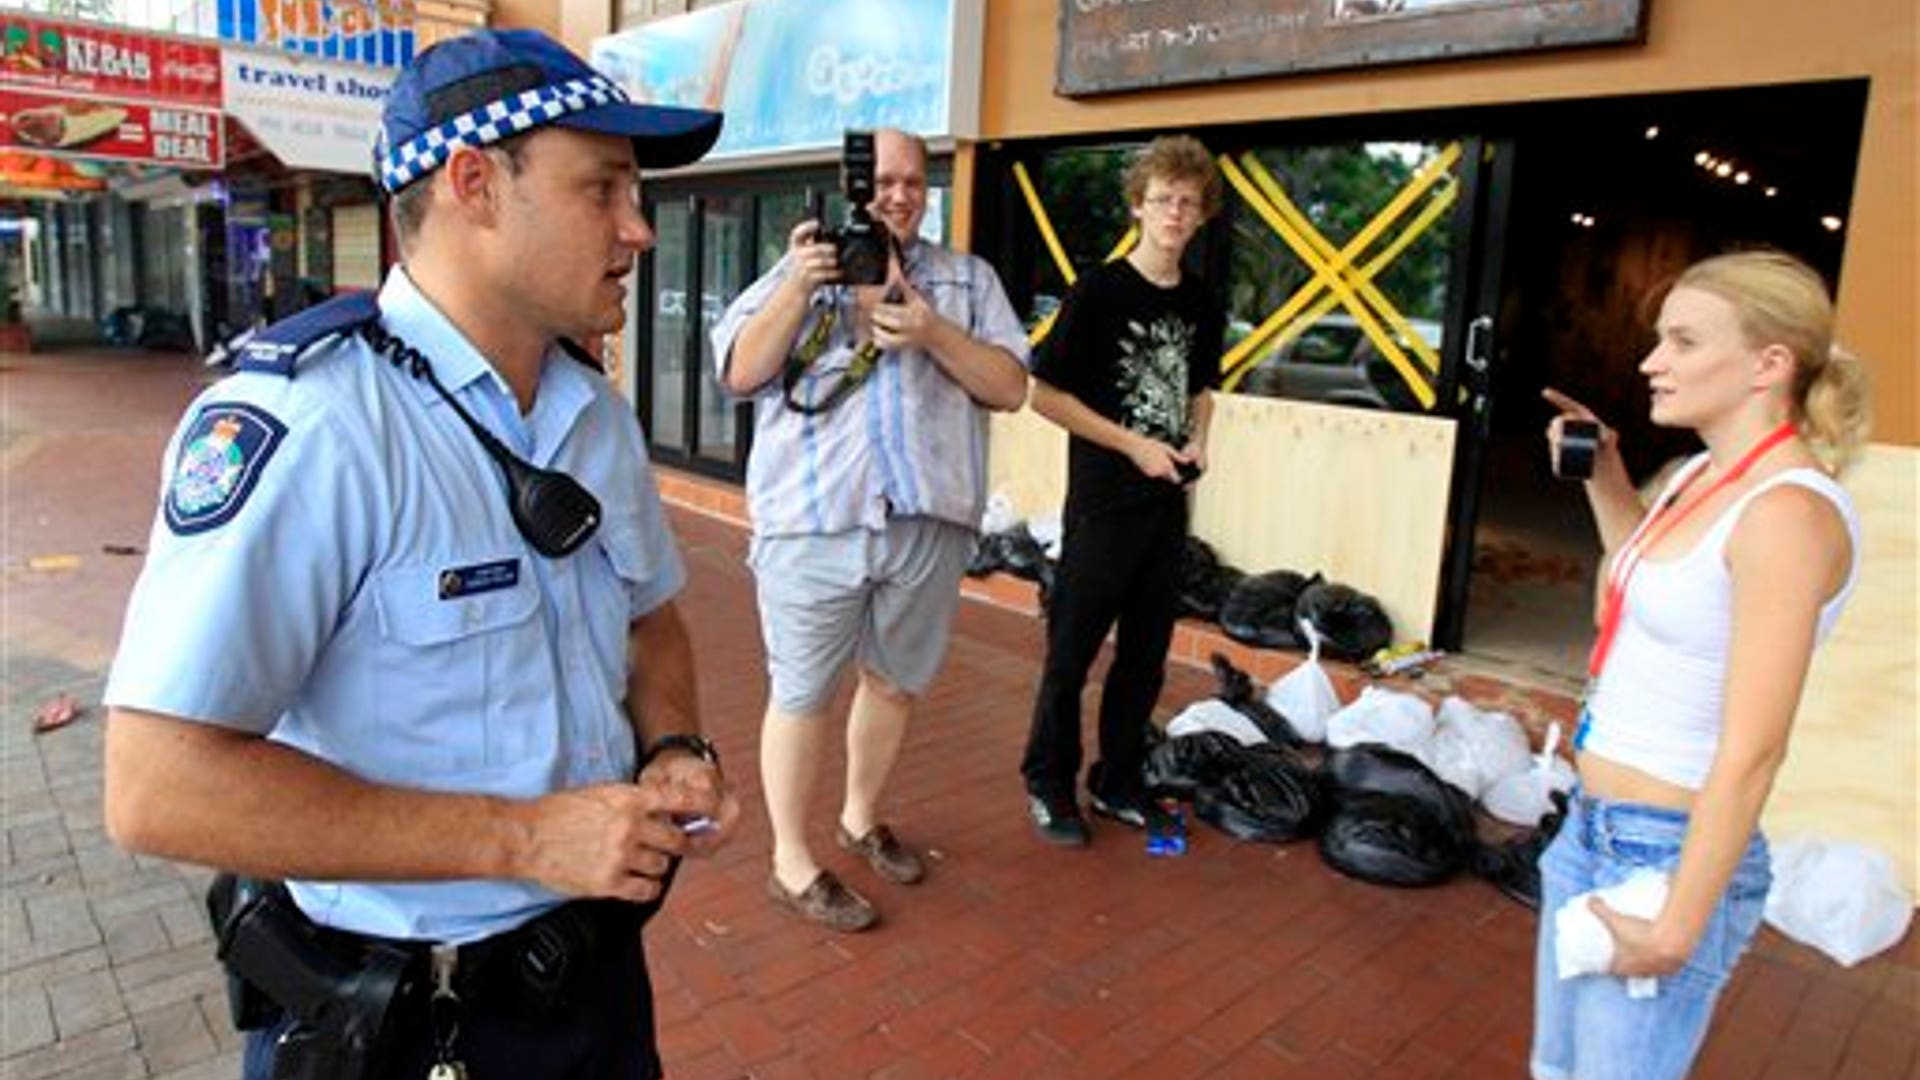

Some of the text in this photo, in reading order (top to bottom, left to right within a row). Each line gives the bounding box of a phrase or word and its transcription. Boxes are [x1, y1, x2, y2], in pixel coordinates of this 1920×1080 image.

[67, 35, 151, 80] KEBAB
[238, 64, 327, 92] travel
[150, 110, 212, 136] MEAL
[153, 135, 213, 161] DEAL
